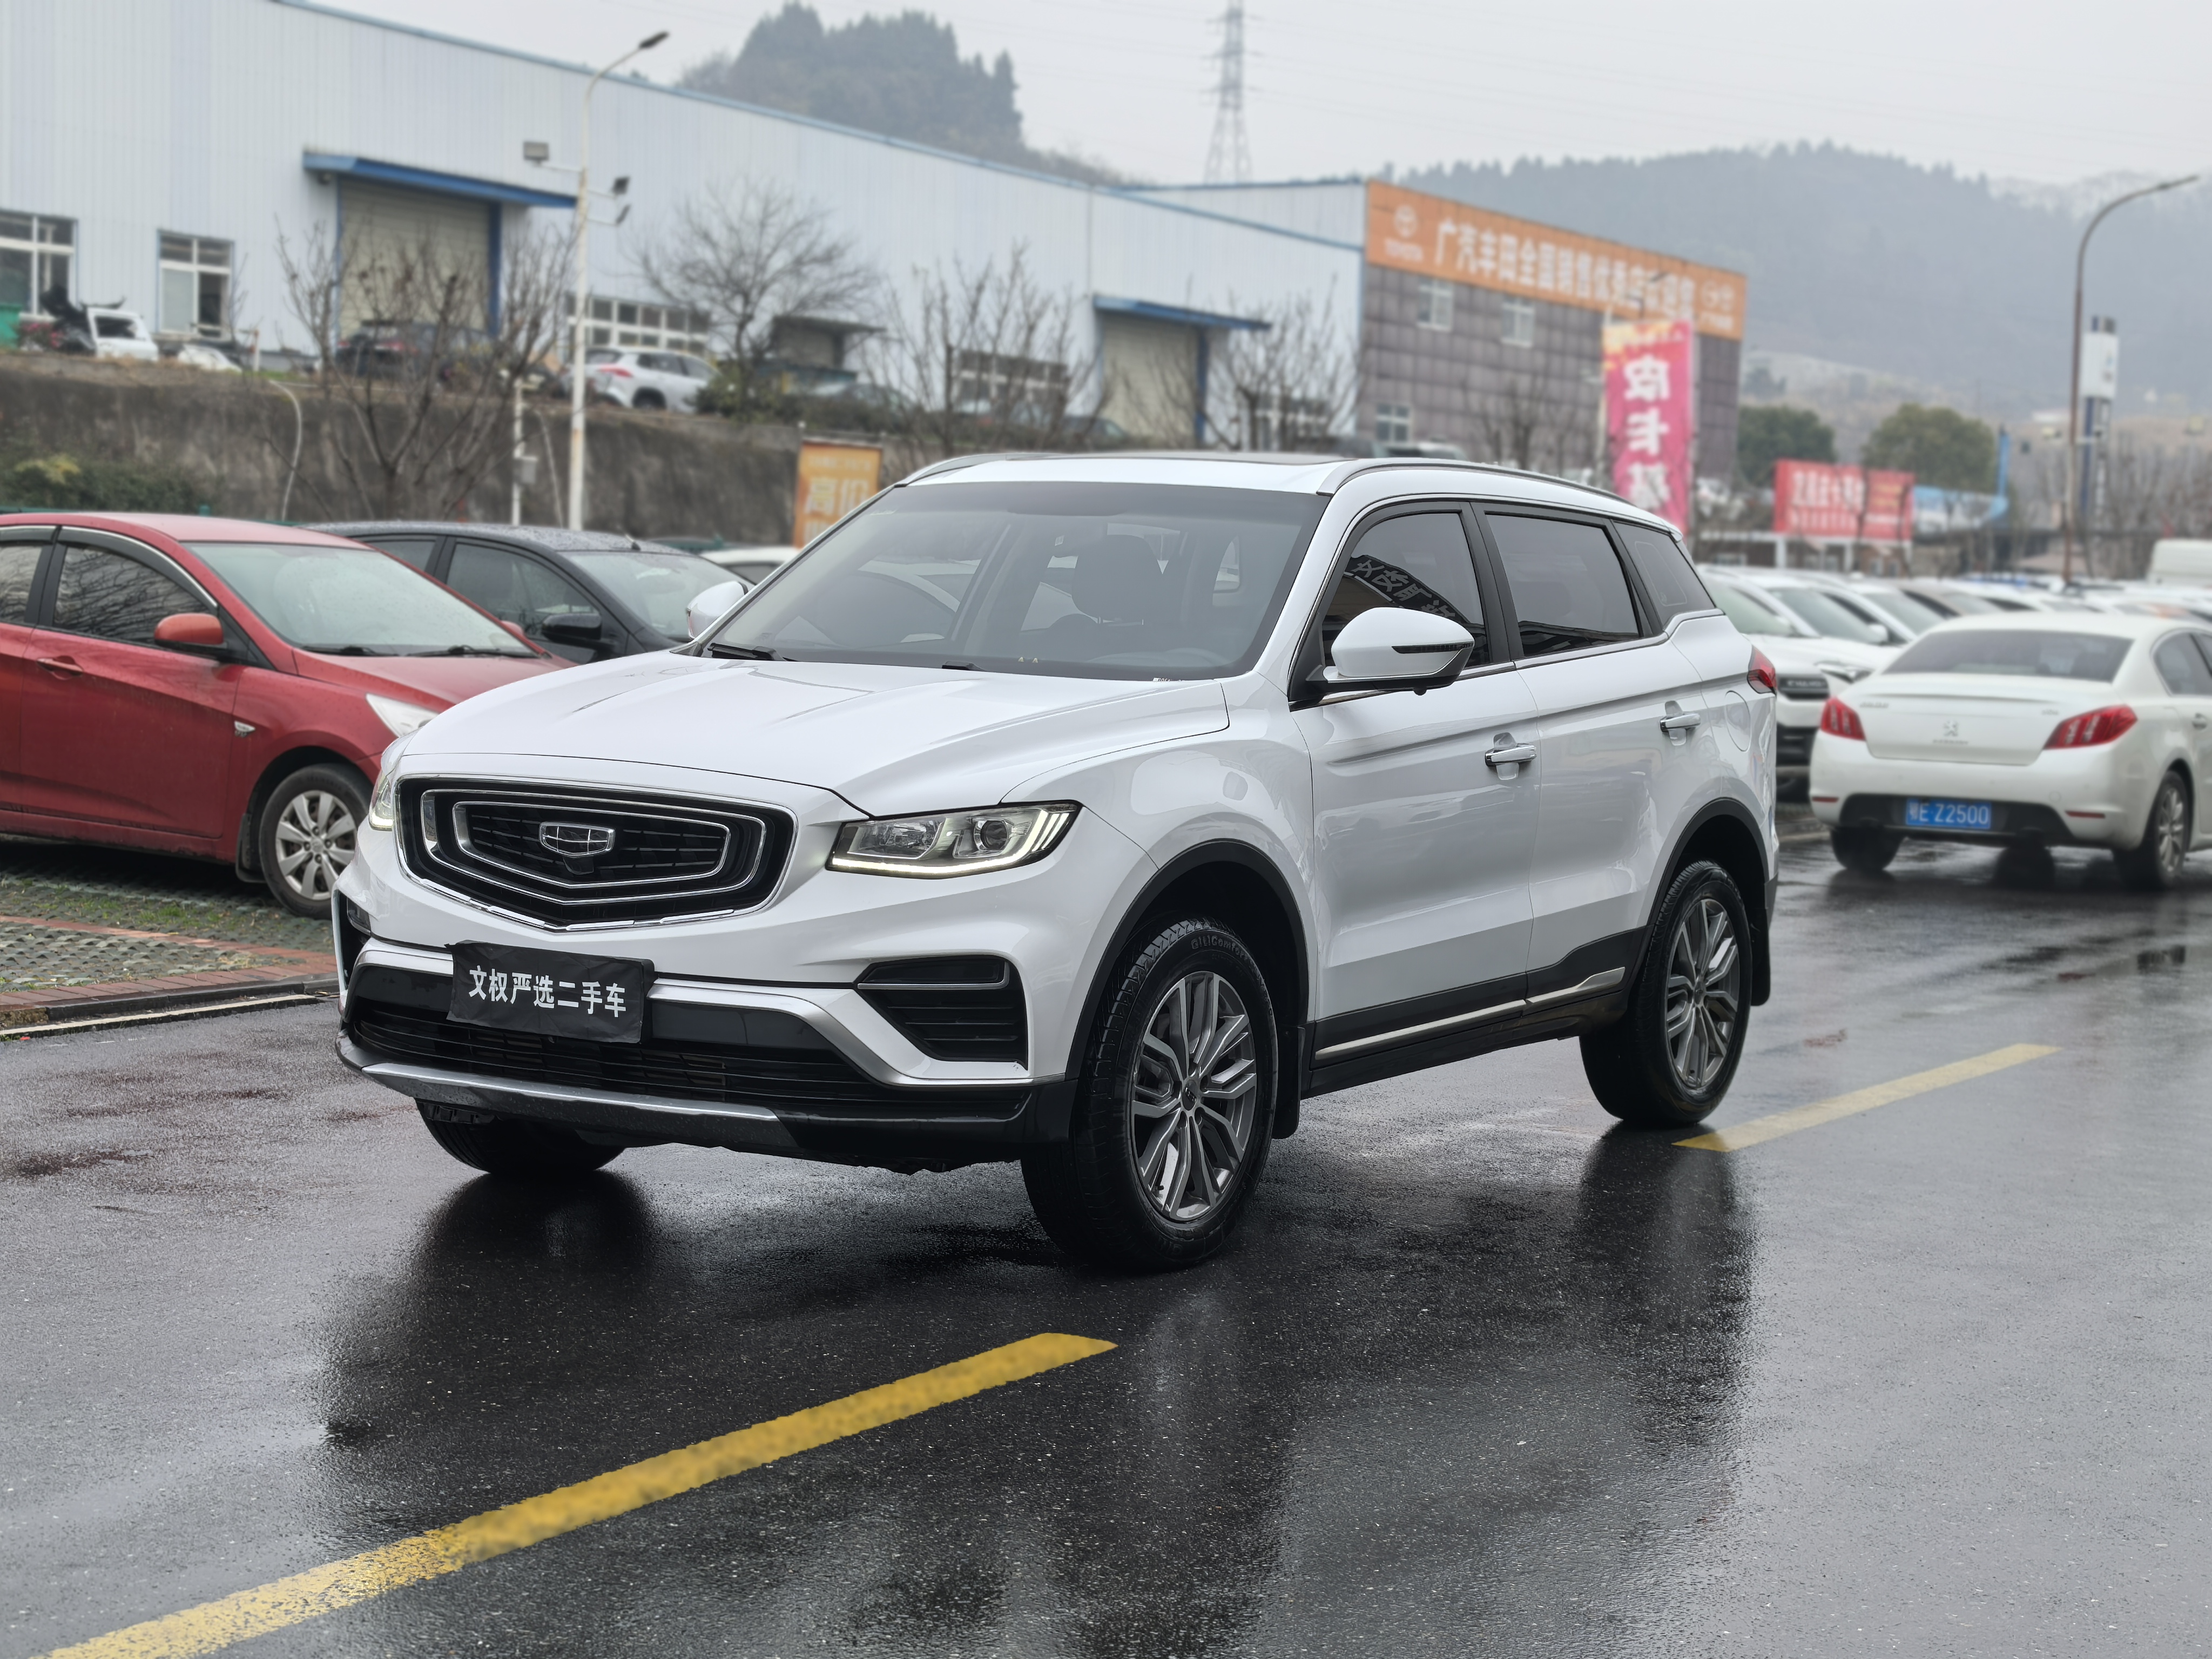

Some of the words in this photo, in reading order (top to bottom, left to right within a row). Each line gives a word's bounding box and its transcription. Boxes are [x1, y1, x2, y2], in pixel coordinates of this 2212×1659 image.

[468, 965, 626, 1018] 文权严选二手车
